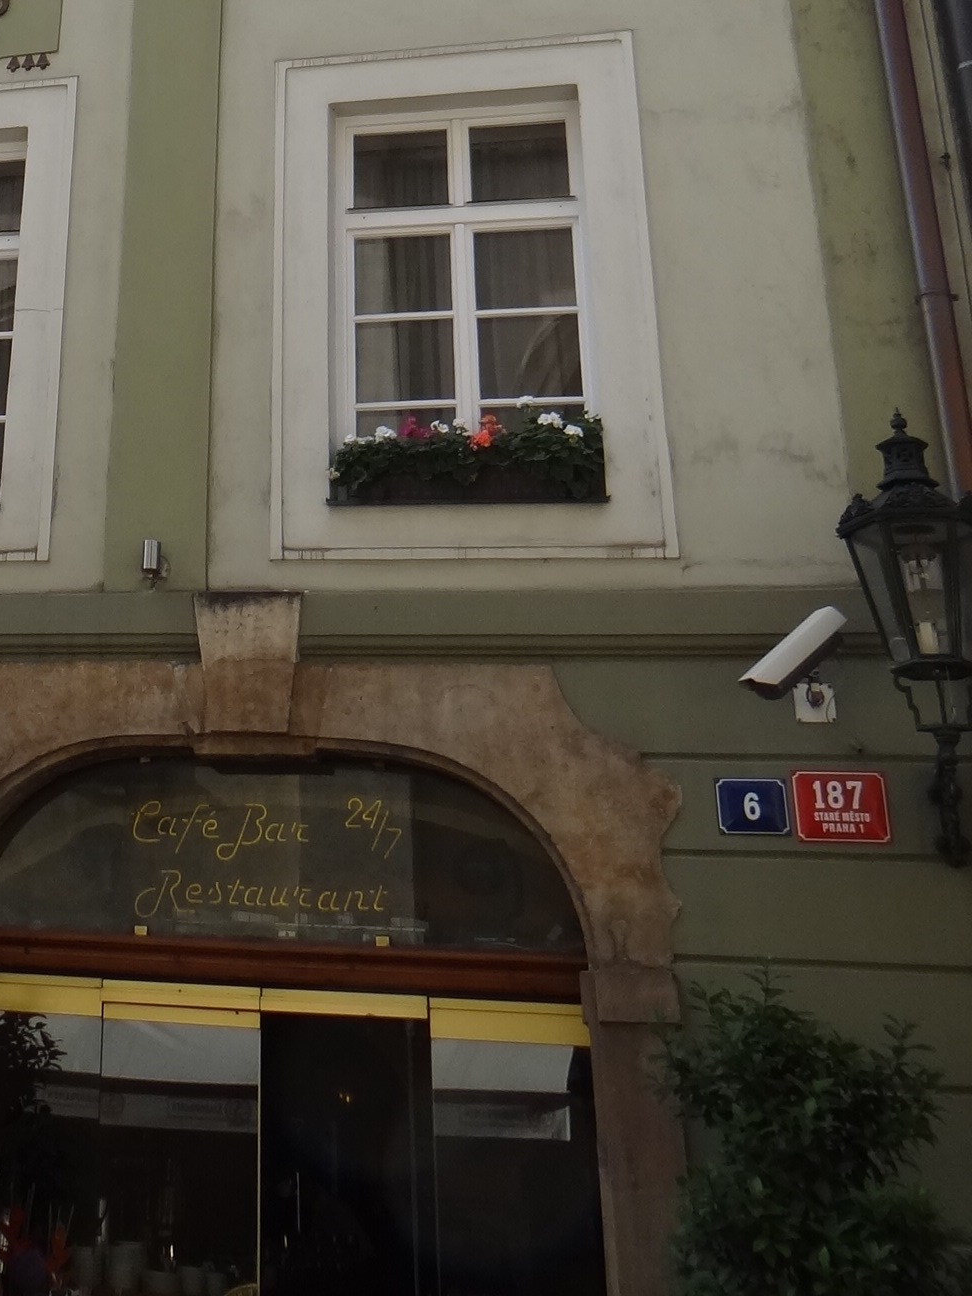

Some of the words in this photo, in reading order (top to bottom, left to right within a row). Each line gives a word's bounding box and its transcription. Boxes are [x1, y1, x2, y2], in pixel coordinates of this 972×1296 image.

[743, 792, 761, 821] 6
[812, 780, 862, 809] 187
[216, 803, 308, 861] Bar
[345, 798, 403, 859] 24/7
[814, 810, 841, 822] STARÉ
[841, 811, 871, 823] MĚSTO
[822, 822, 856, 833] PRAHA
[859, 823, 865, 834] 1
[134, 869, 389, 918] Restaurant
